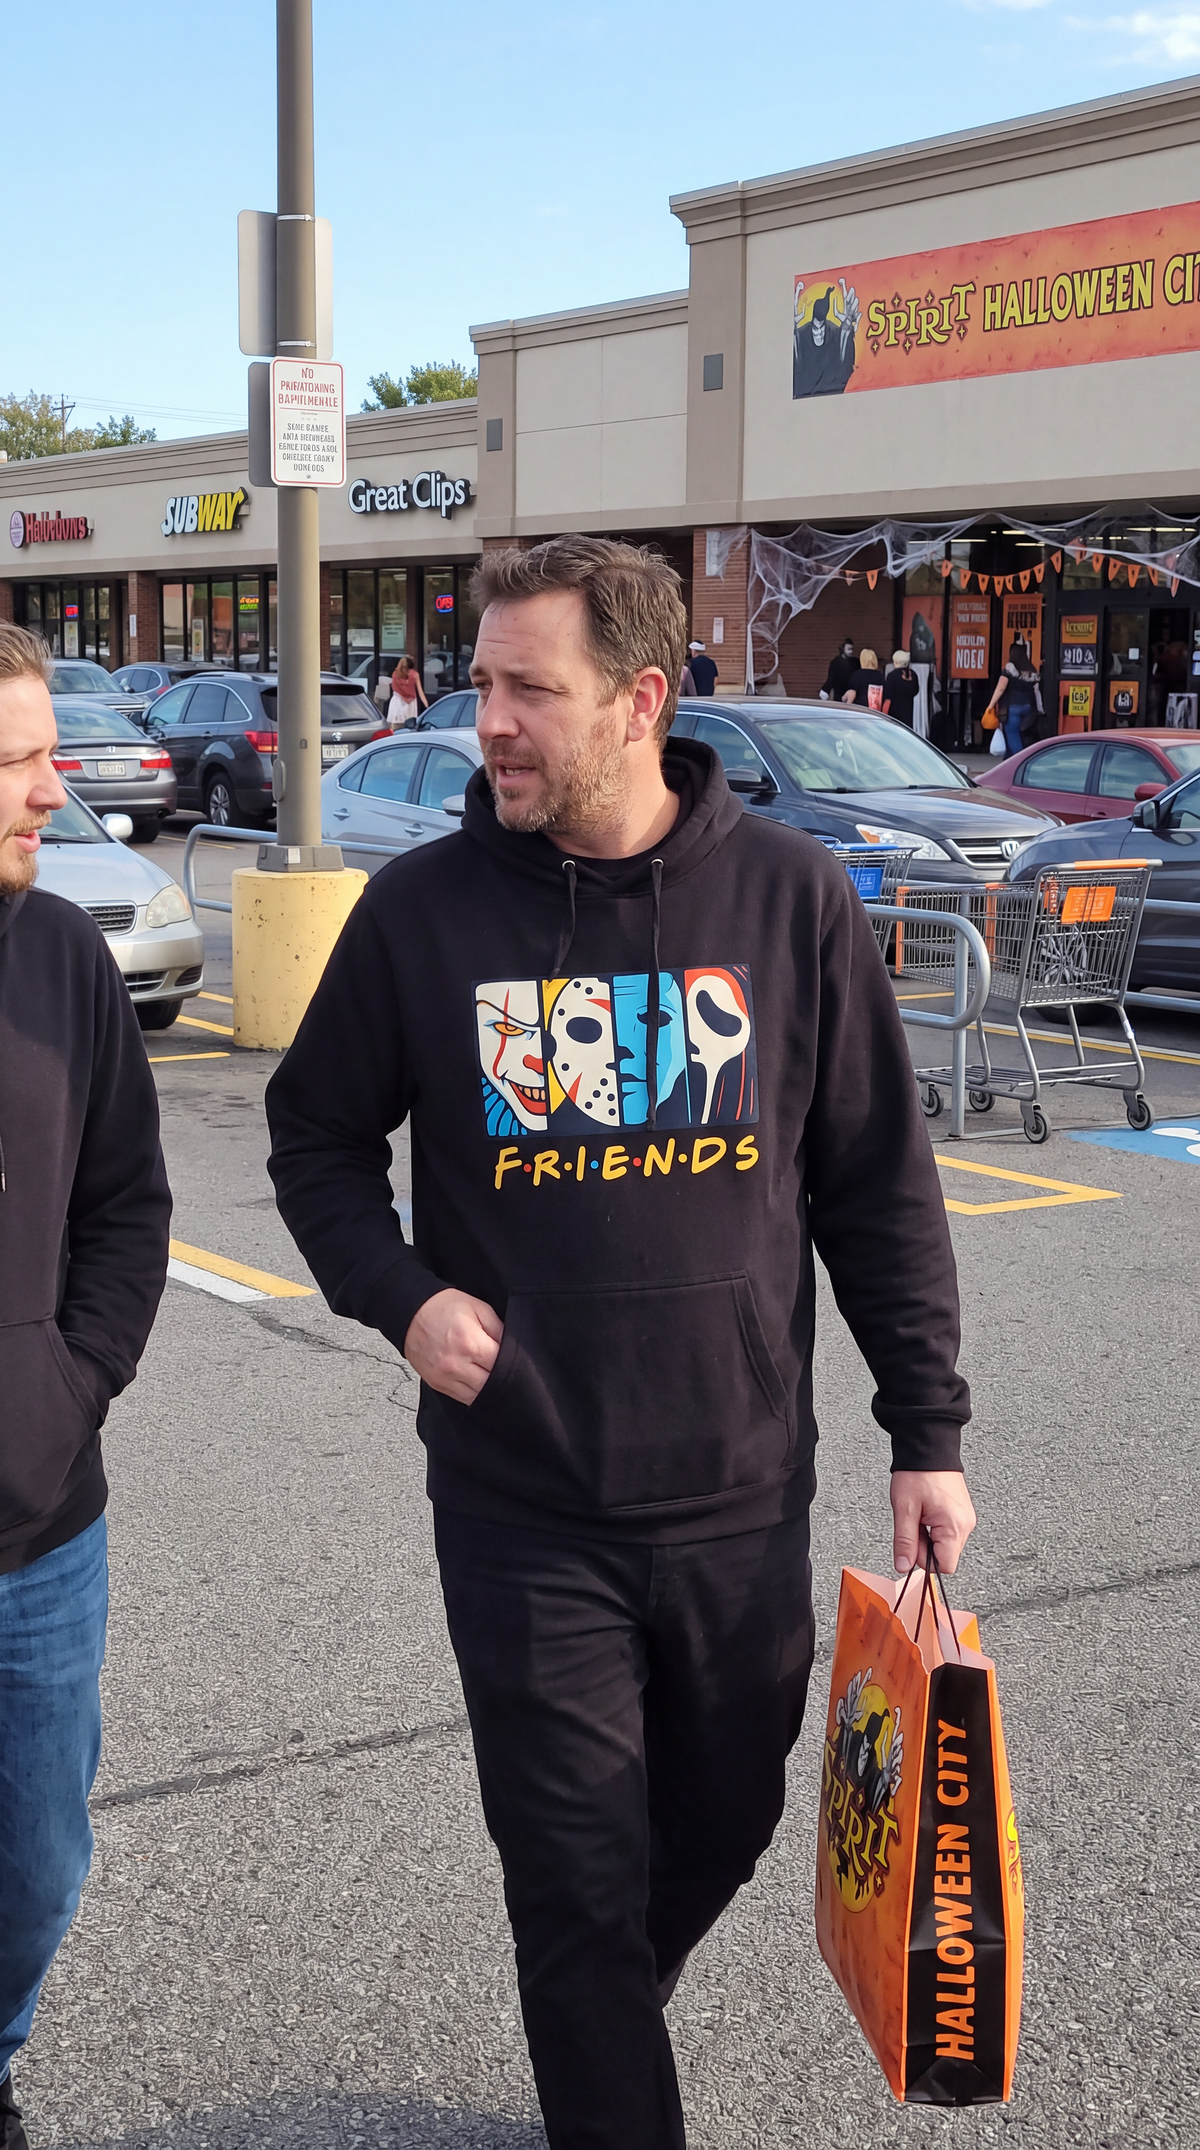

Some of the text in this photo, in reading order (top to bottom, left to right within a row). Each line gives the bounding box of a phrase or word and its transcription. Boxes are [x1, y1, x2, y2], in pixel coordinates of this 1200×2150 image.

[866, 250, 1200, 347] SPIRIT HALLOWEEN CI
[160, 487, 246, 534] SUBWAY
[348, 472, 467, 518] Great Clips
[824, 1737, 900, 1878] SPIRIT
[934, 1719, 975, 2062] HALLOWEEN CITY
